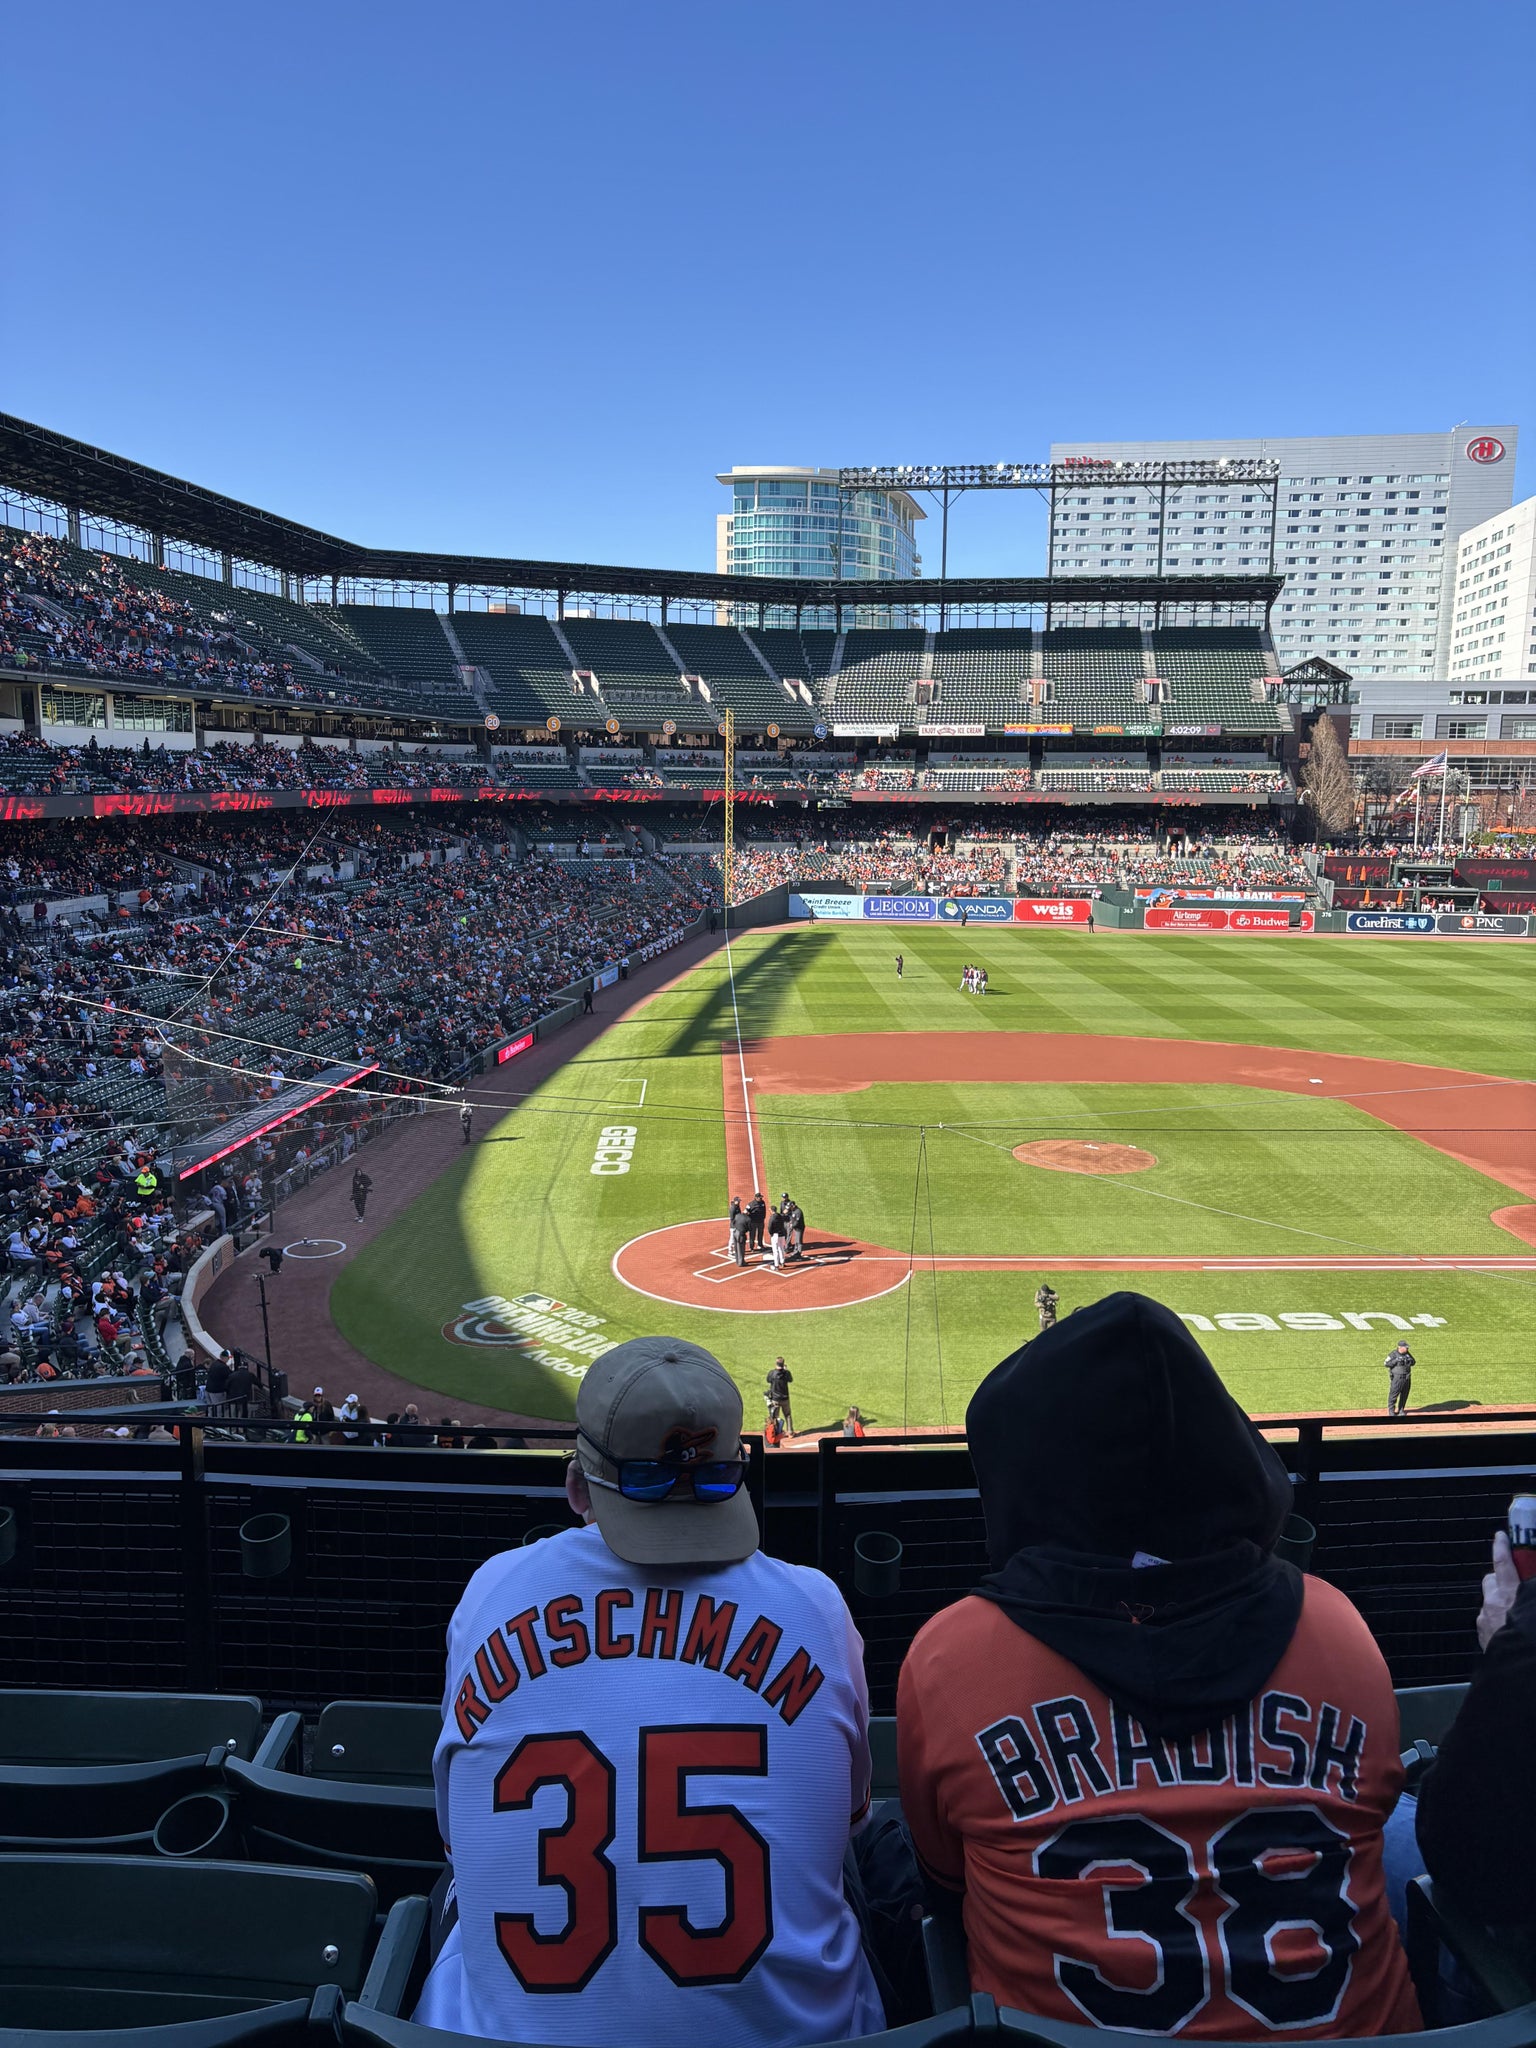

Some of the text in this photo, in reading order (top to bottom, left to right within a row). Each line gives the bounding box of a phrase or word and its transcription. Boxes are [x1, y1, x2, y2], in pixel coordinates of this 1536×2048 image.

[1169, 726, 1202, 735] 4:02:09
[1213, 891, 1241, 899] BIRD
[1244, 892, 1272, 900] BATH
[870, 900, 930, 912] LECOM
[958, 904, 1007, 914] VANDA
[1032, 902, 1074, 916] weis
[1173, 911, 1202, 921] Airtemp
[1356, 916, 1404, 929] CareFirst
[1476, 917, 1503, 928] PNC
[590, 1125, 638, 1176] GEICO
[552, 1307, 607, 1328] 2026
[461, 1295, 619, 1359] OPENING DA
[520, 1349, 589, 1379] Adob
[453, 1588, 826, 1743] RUTSCHMAN
[493, 1724, 774, 1994] 35
[1031, 1804, 1361, 2037] 38
